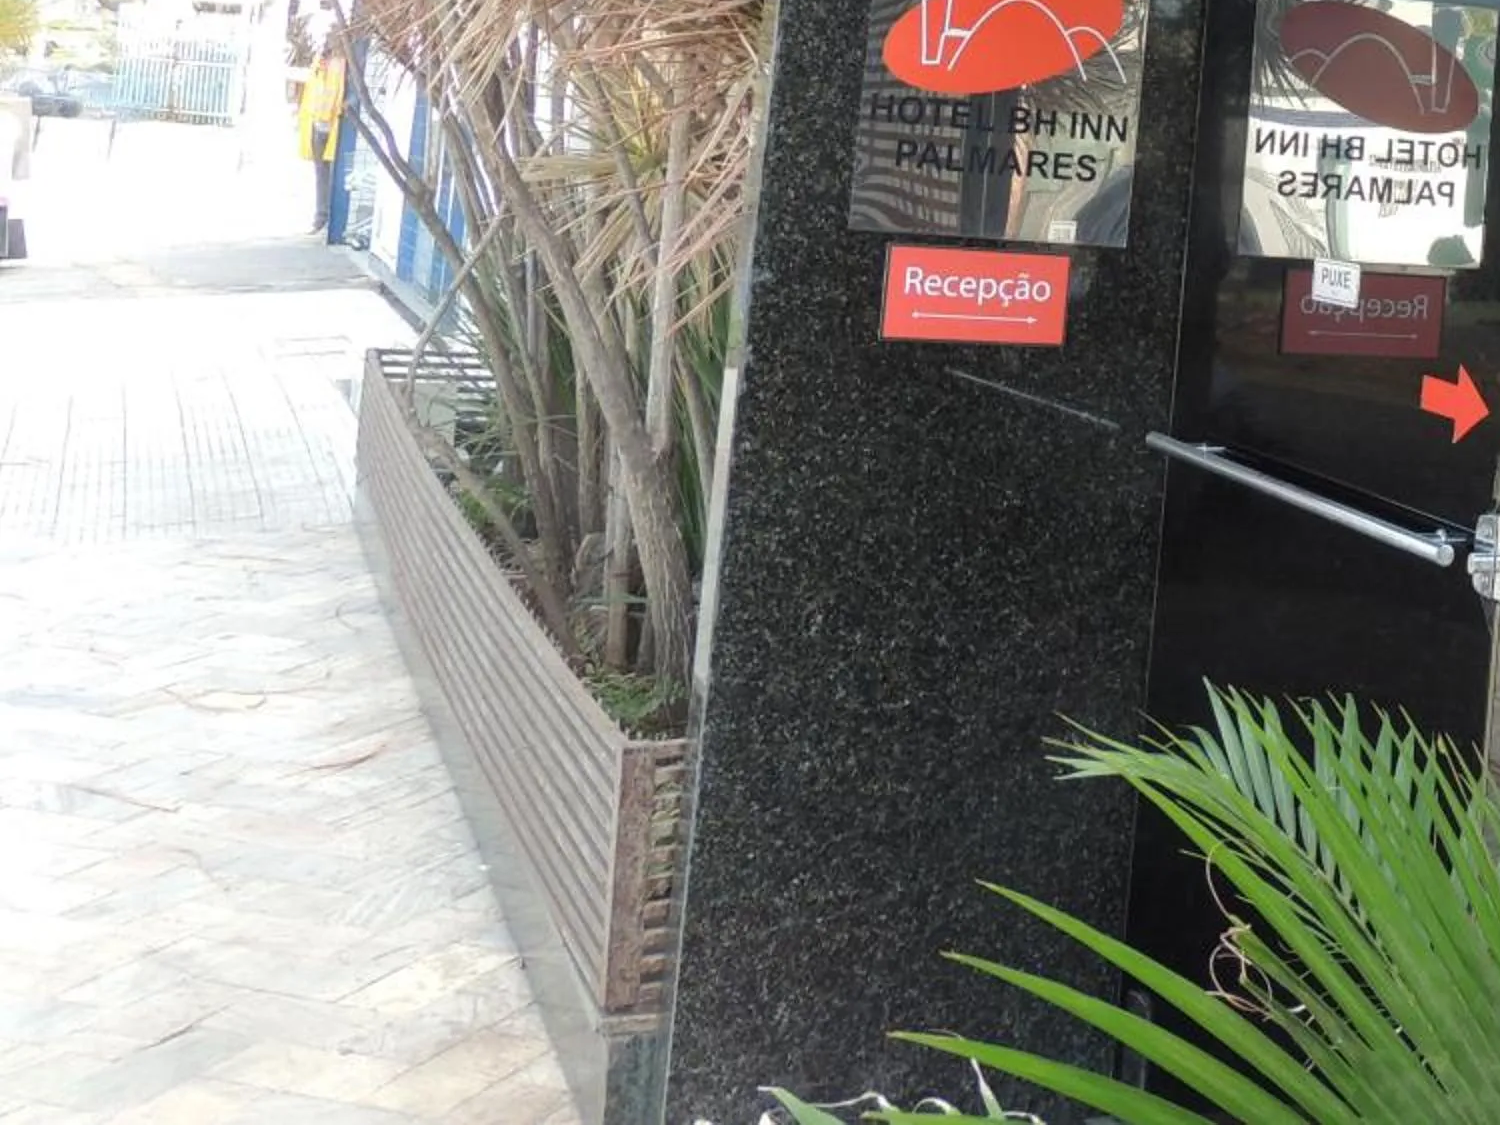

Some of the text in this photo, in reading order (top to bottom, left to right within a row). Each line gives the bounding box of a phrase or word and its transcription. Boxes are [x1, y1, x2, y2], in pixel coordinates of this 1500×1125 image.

[870, 93, 1129, 143] HOTEL BH INN
[895, 138, 1098, 182] PALMARES
[904, 266, 1052, 308] Recepção
[1320, 266, 1352, 290] PUXE
